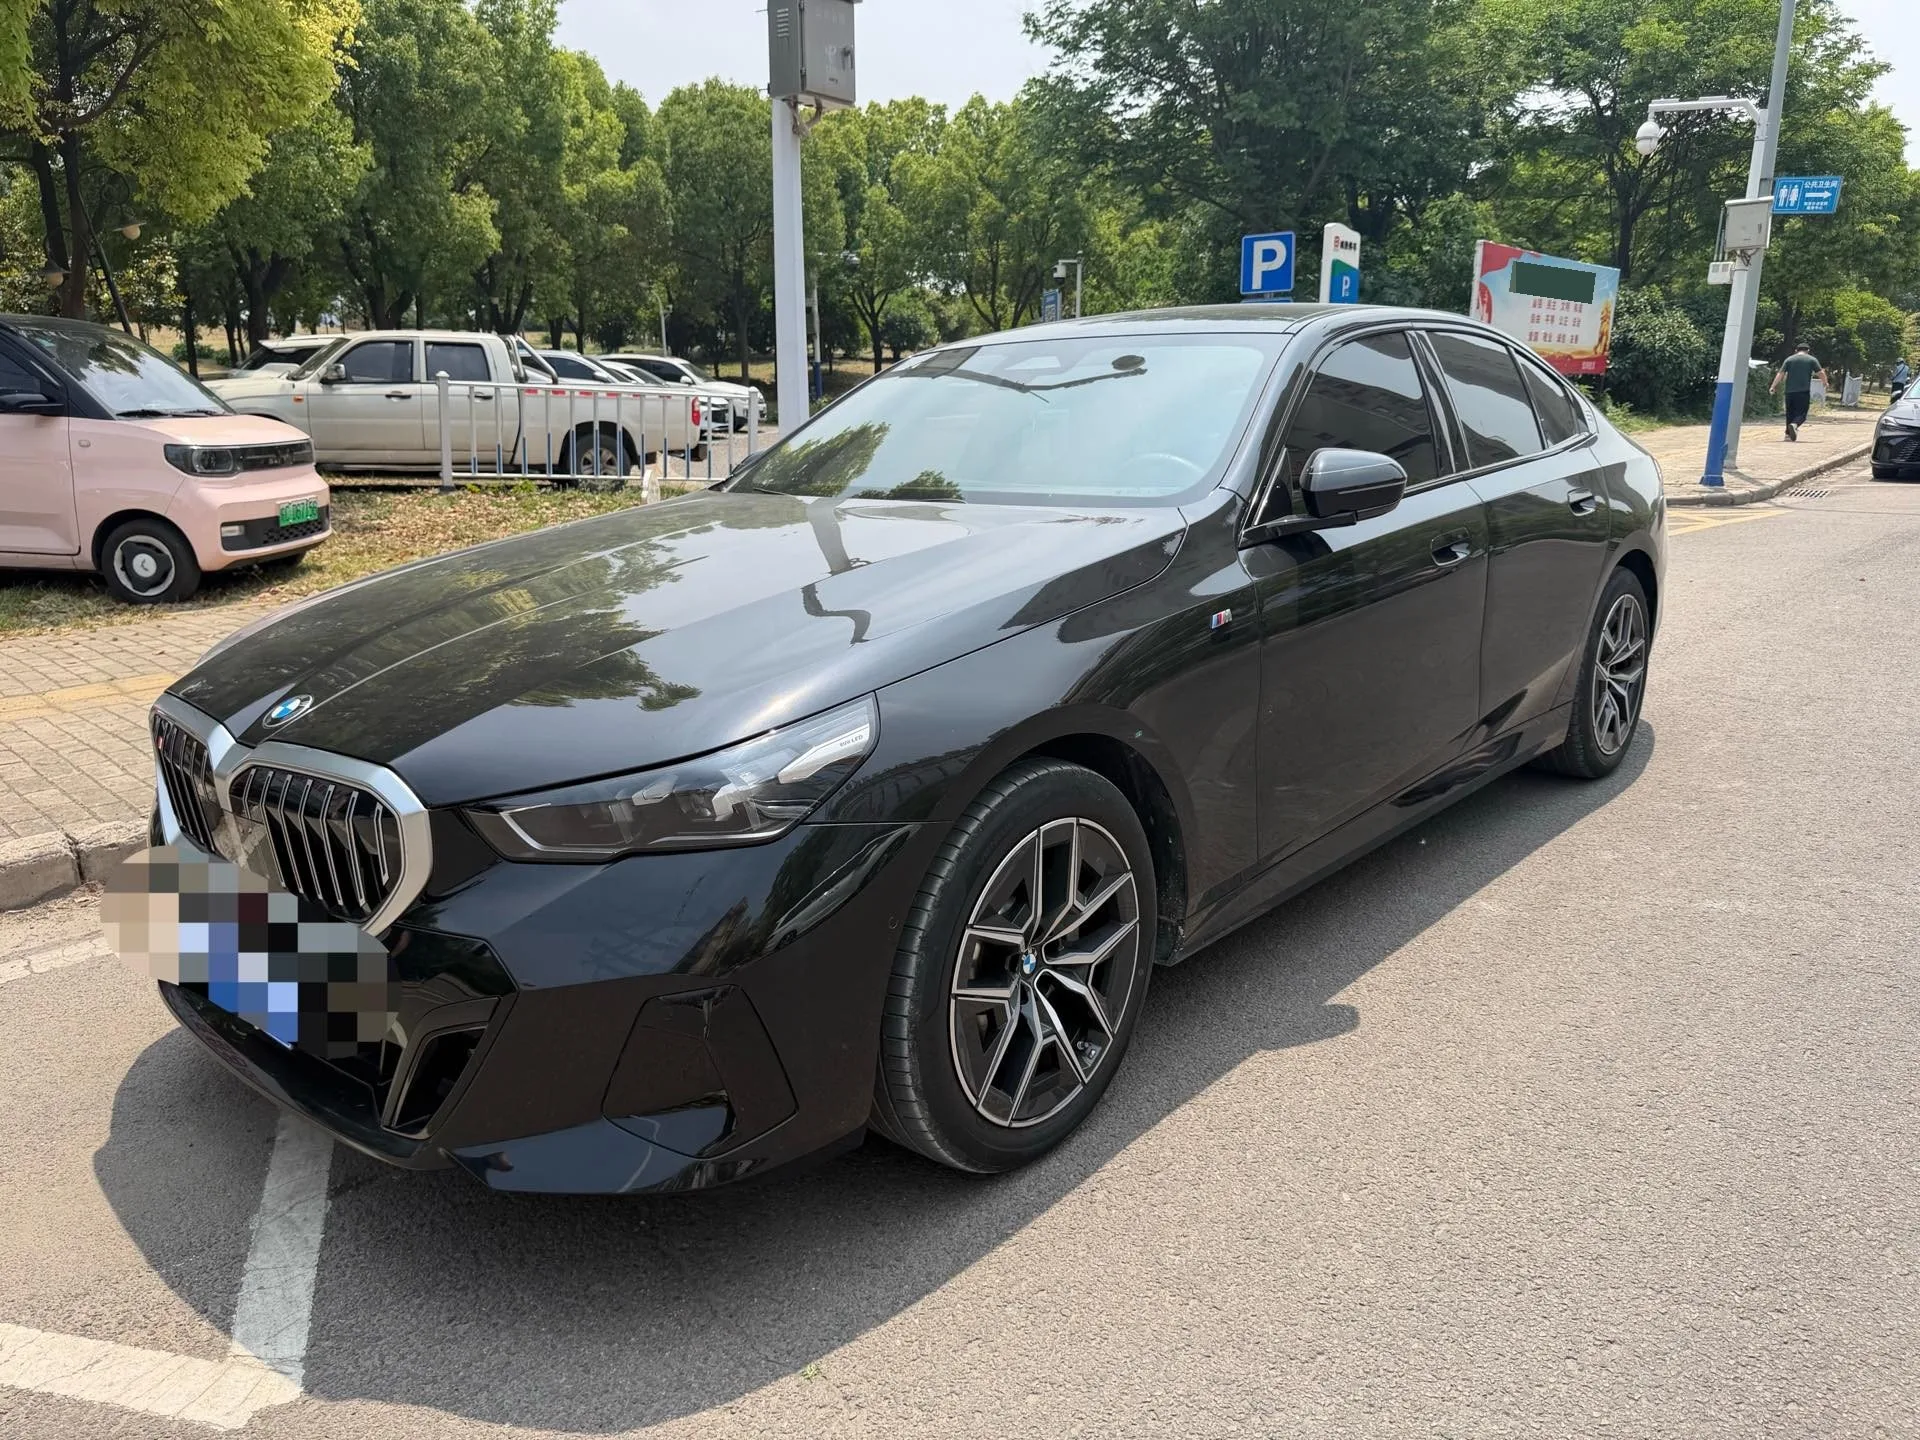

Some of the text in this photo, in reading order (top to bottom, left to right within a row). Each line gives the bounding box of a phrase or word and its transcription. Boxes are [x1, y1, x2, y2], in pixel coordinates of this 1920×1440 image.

[1804, 180, 1838, 188] 公共卫生间
[1252, 239, 1287, 290] P
[1341, 275, 1351, 297] P
